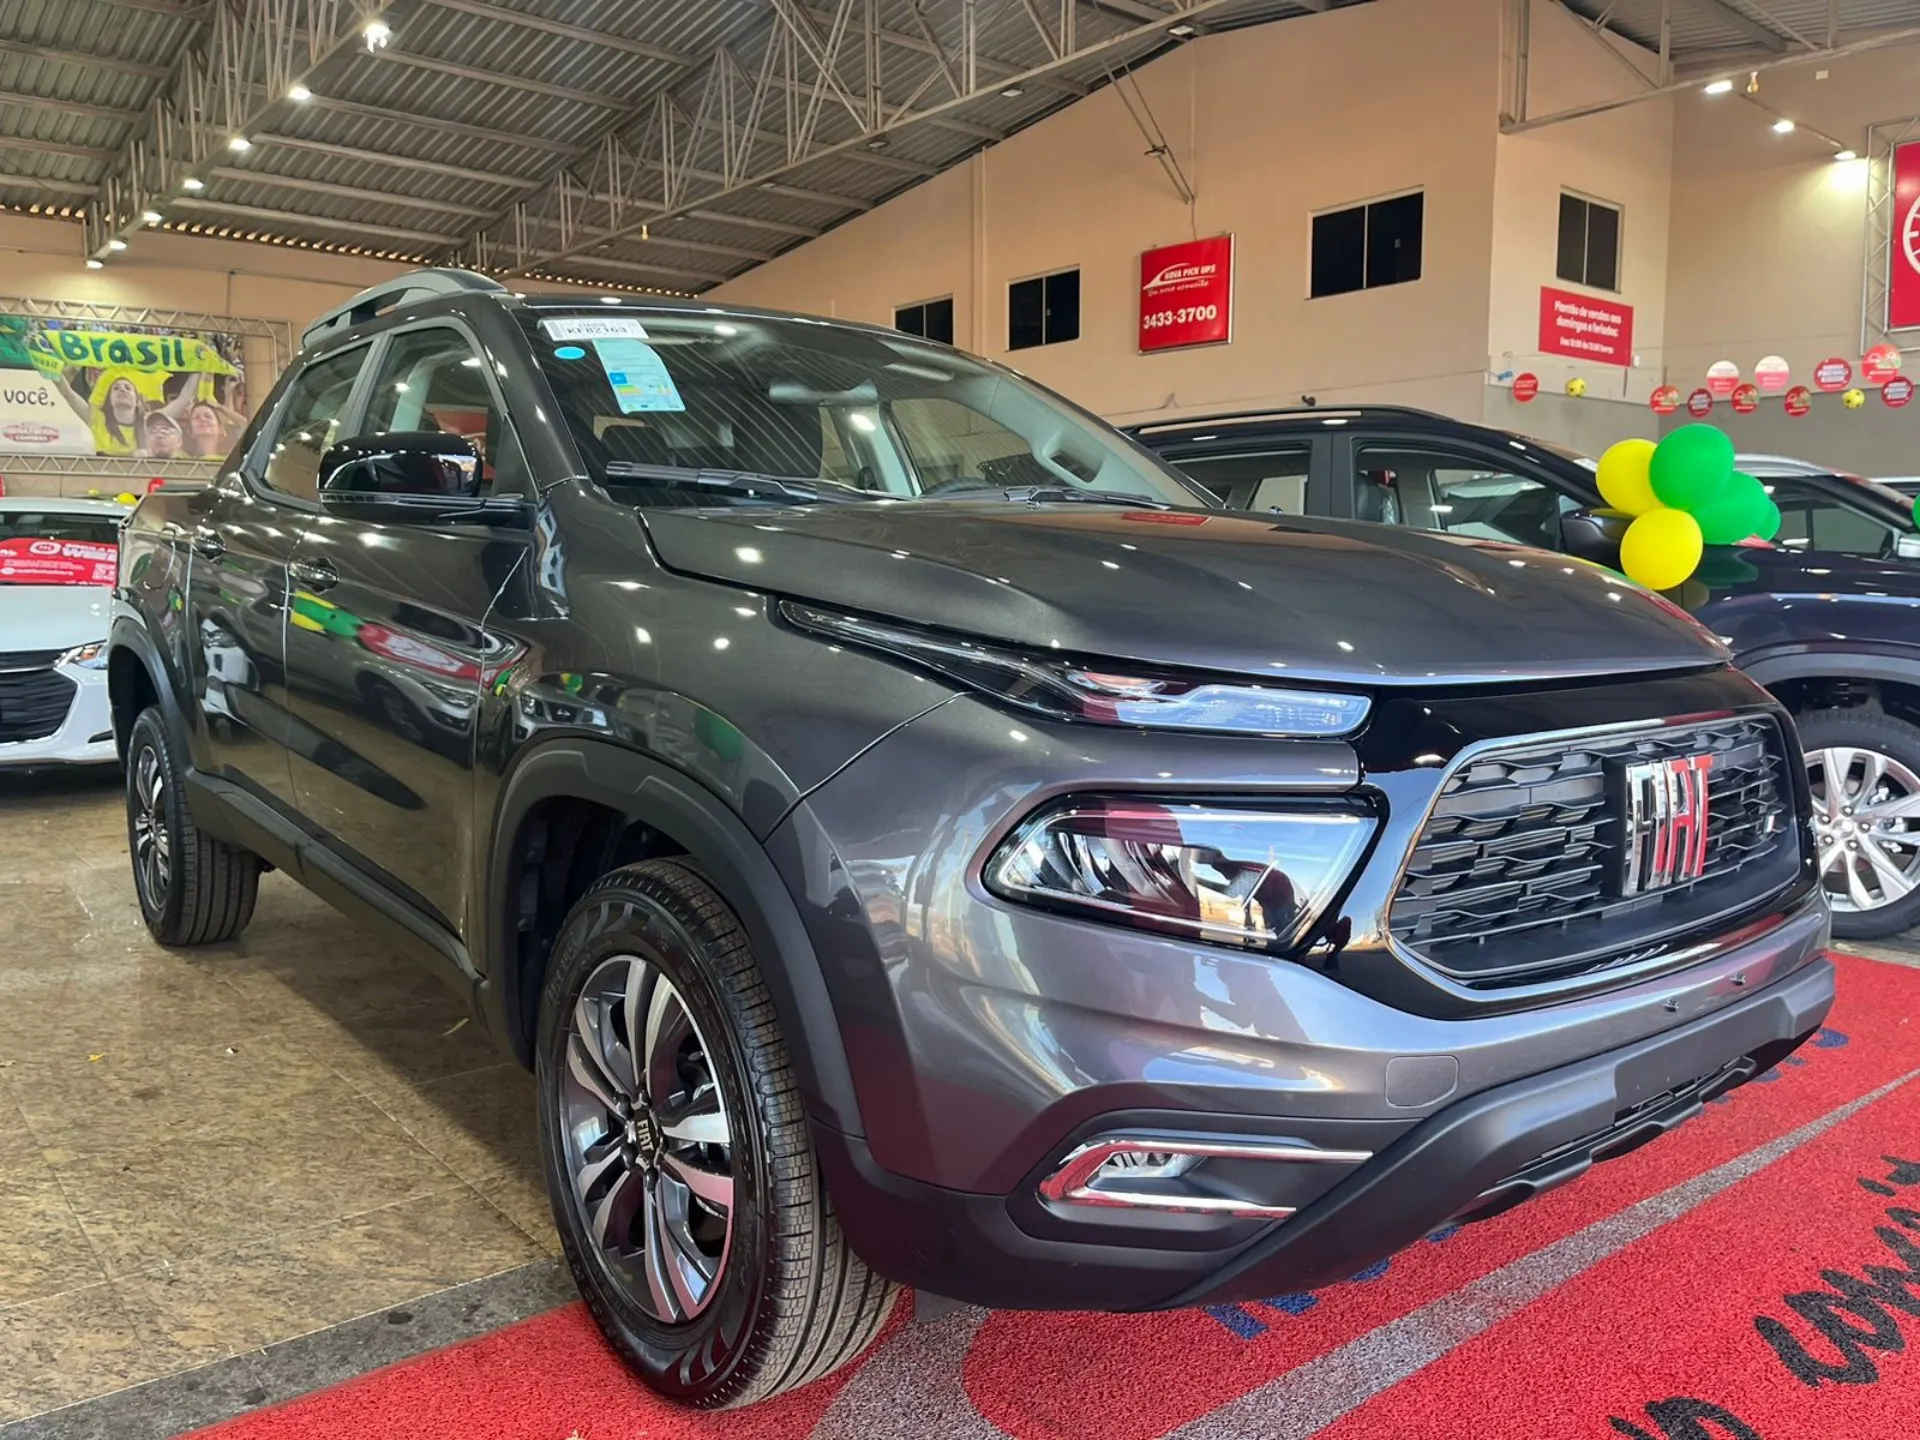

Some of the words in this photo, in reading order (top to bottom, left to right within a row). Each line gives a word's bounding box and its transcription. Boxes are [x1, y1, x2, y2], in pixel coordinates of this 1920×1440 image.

[1182, 267, 1199, 277] PICK
[1200, 264, 1217, 275] UPS
[1143, 304, 1217, 330] 3433-3700
[59, 331, 187, 367] Brasil
[1622, 752, 1714, 898] FIAT
[637, 1119, 655, 1151] FIAT
